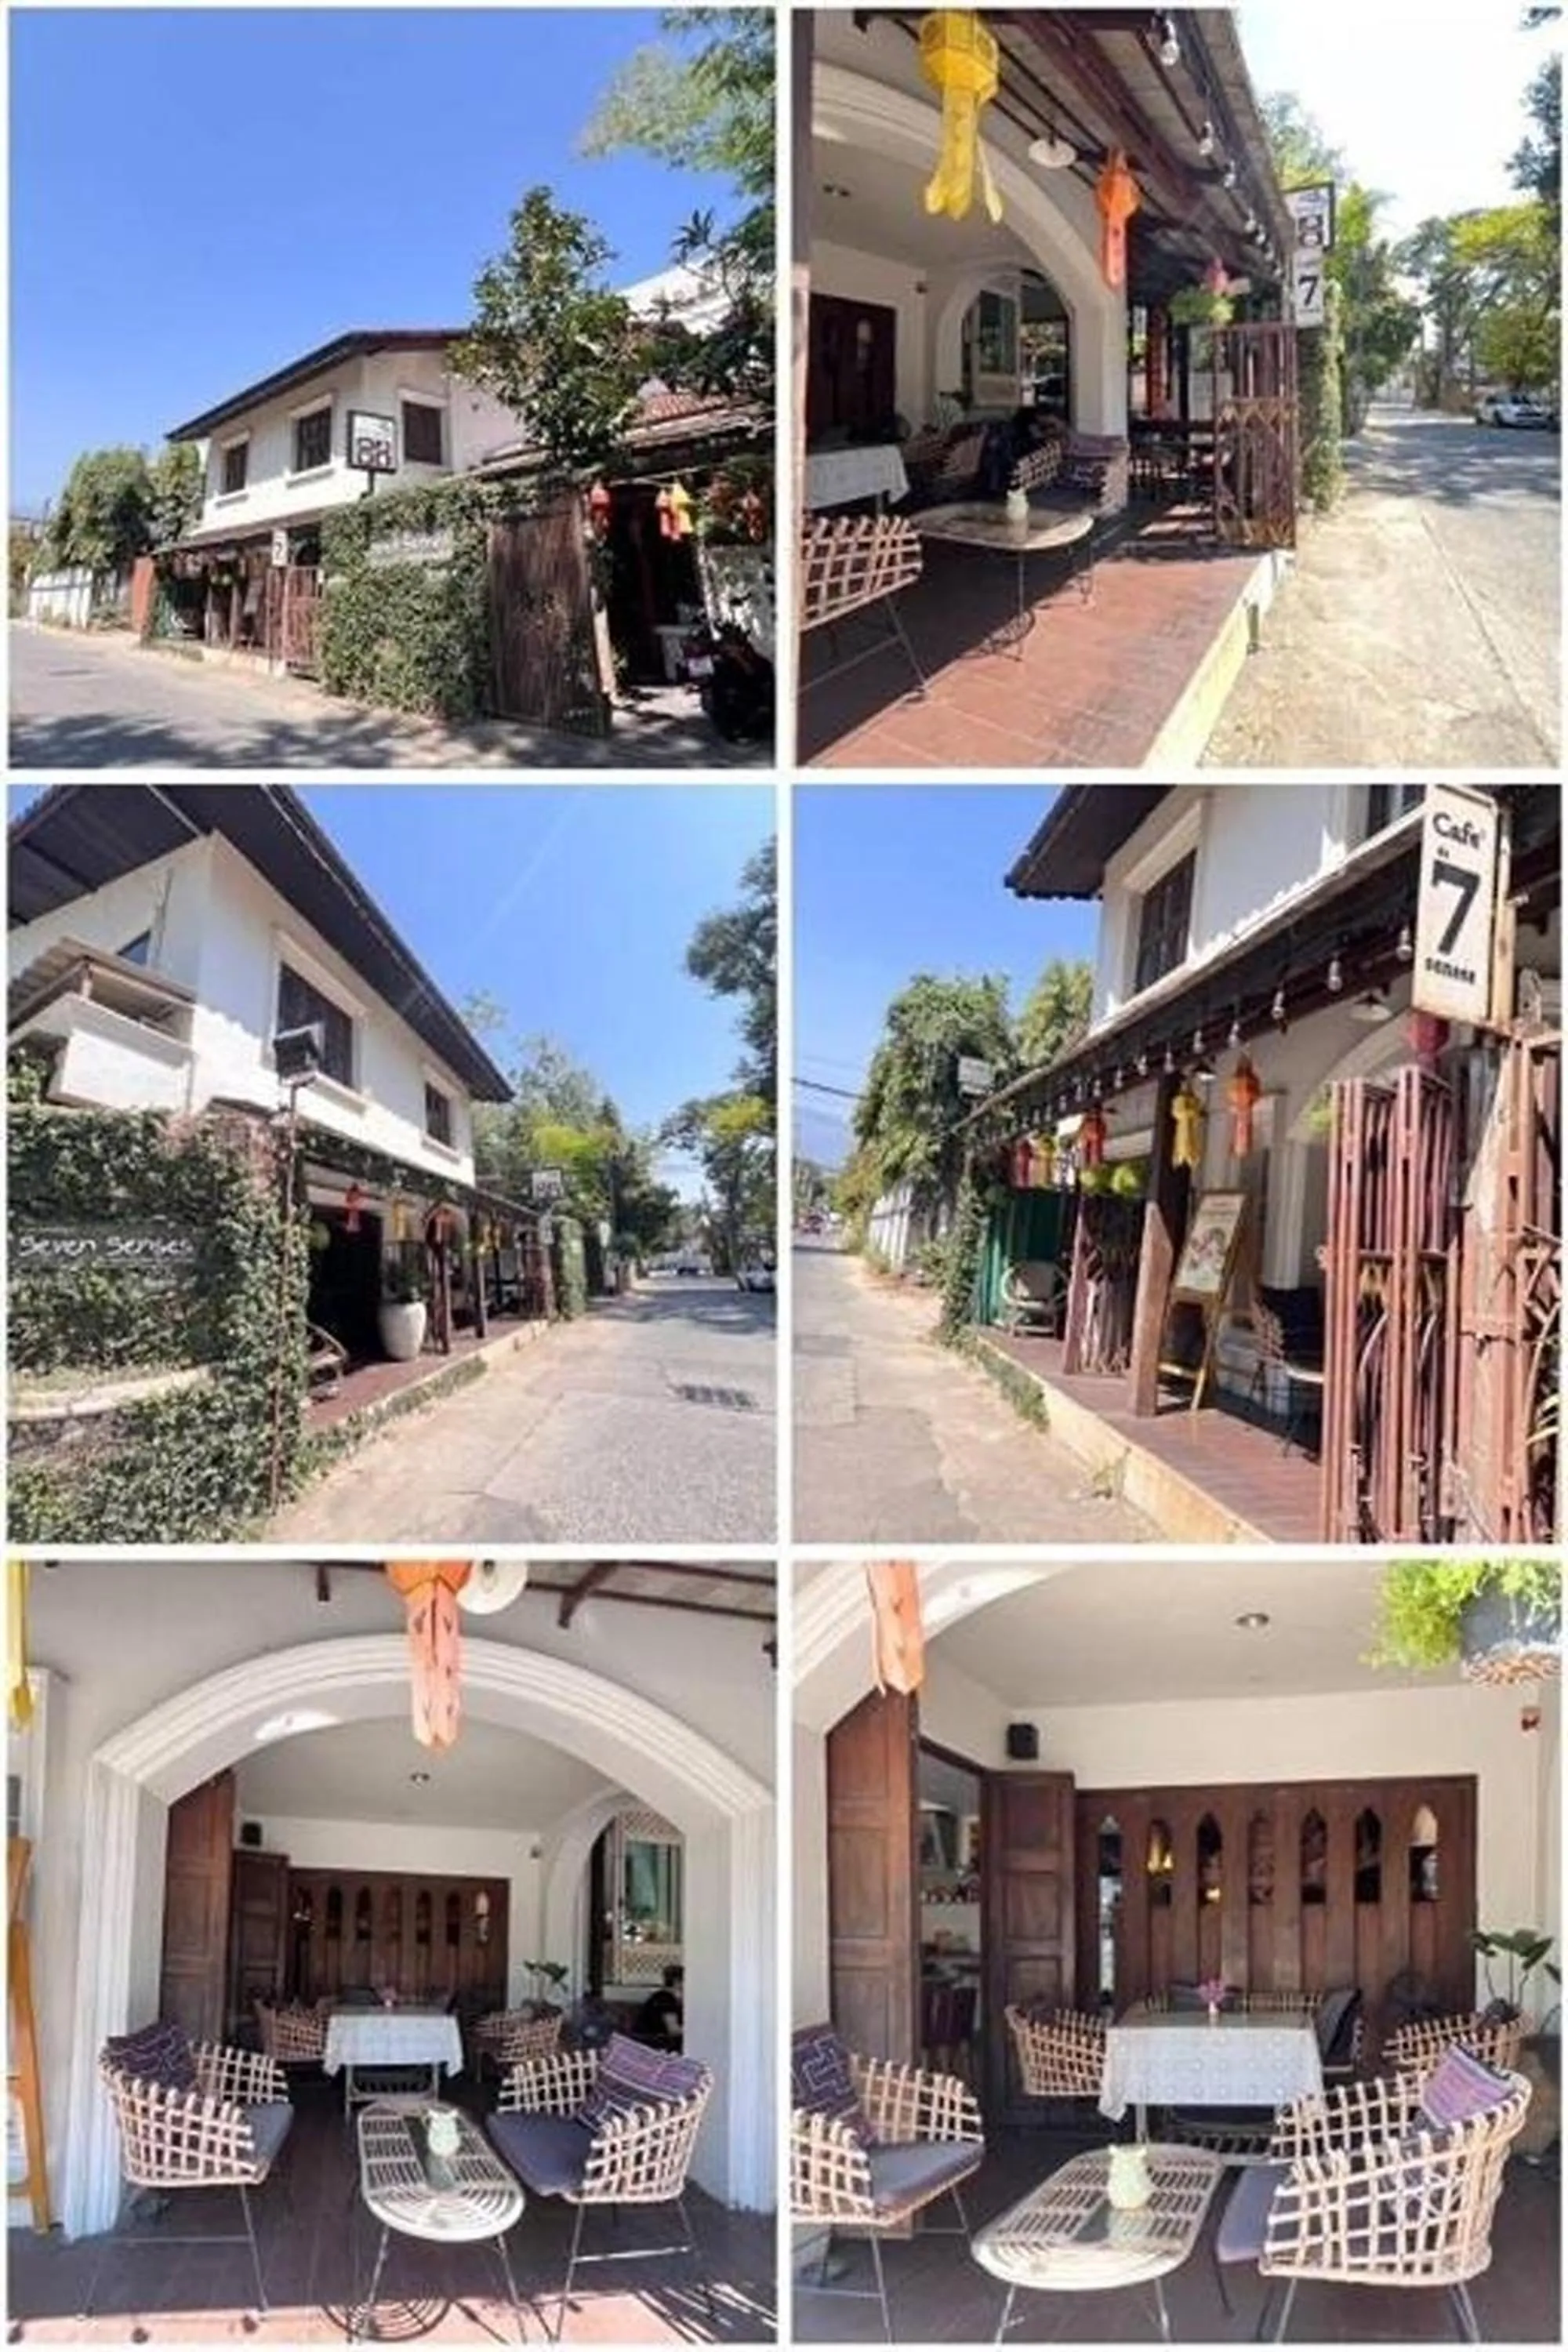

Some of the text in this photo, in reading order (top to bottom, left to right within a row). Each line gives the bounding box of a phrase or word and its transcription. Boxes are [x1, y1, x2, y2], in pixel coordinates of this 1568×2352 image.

[1298, 275, 1317, 306] 7
[1432, 859, 1480, 955] 7
[18, 1236, 97, 1258] Seven
